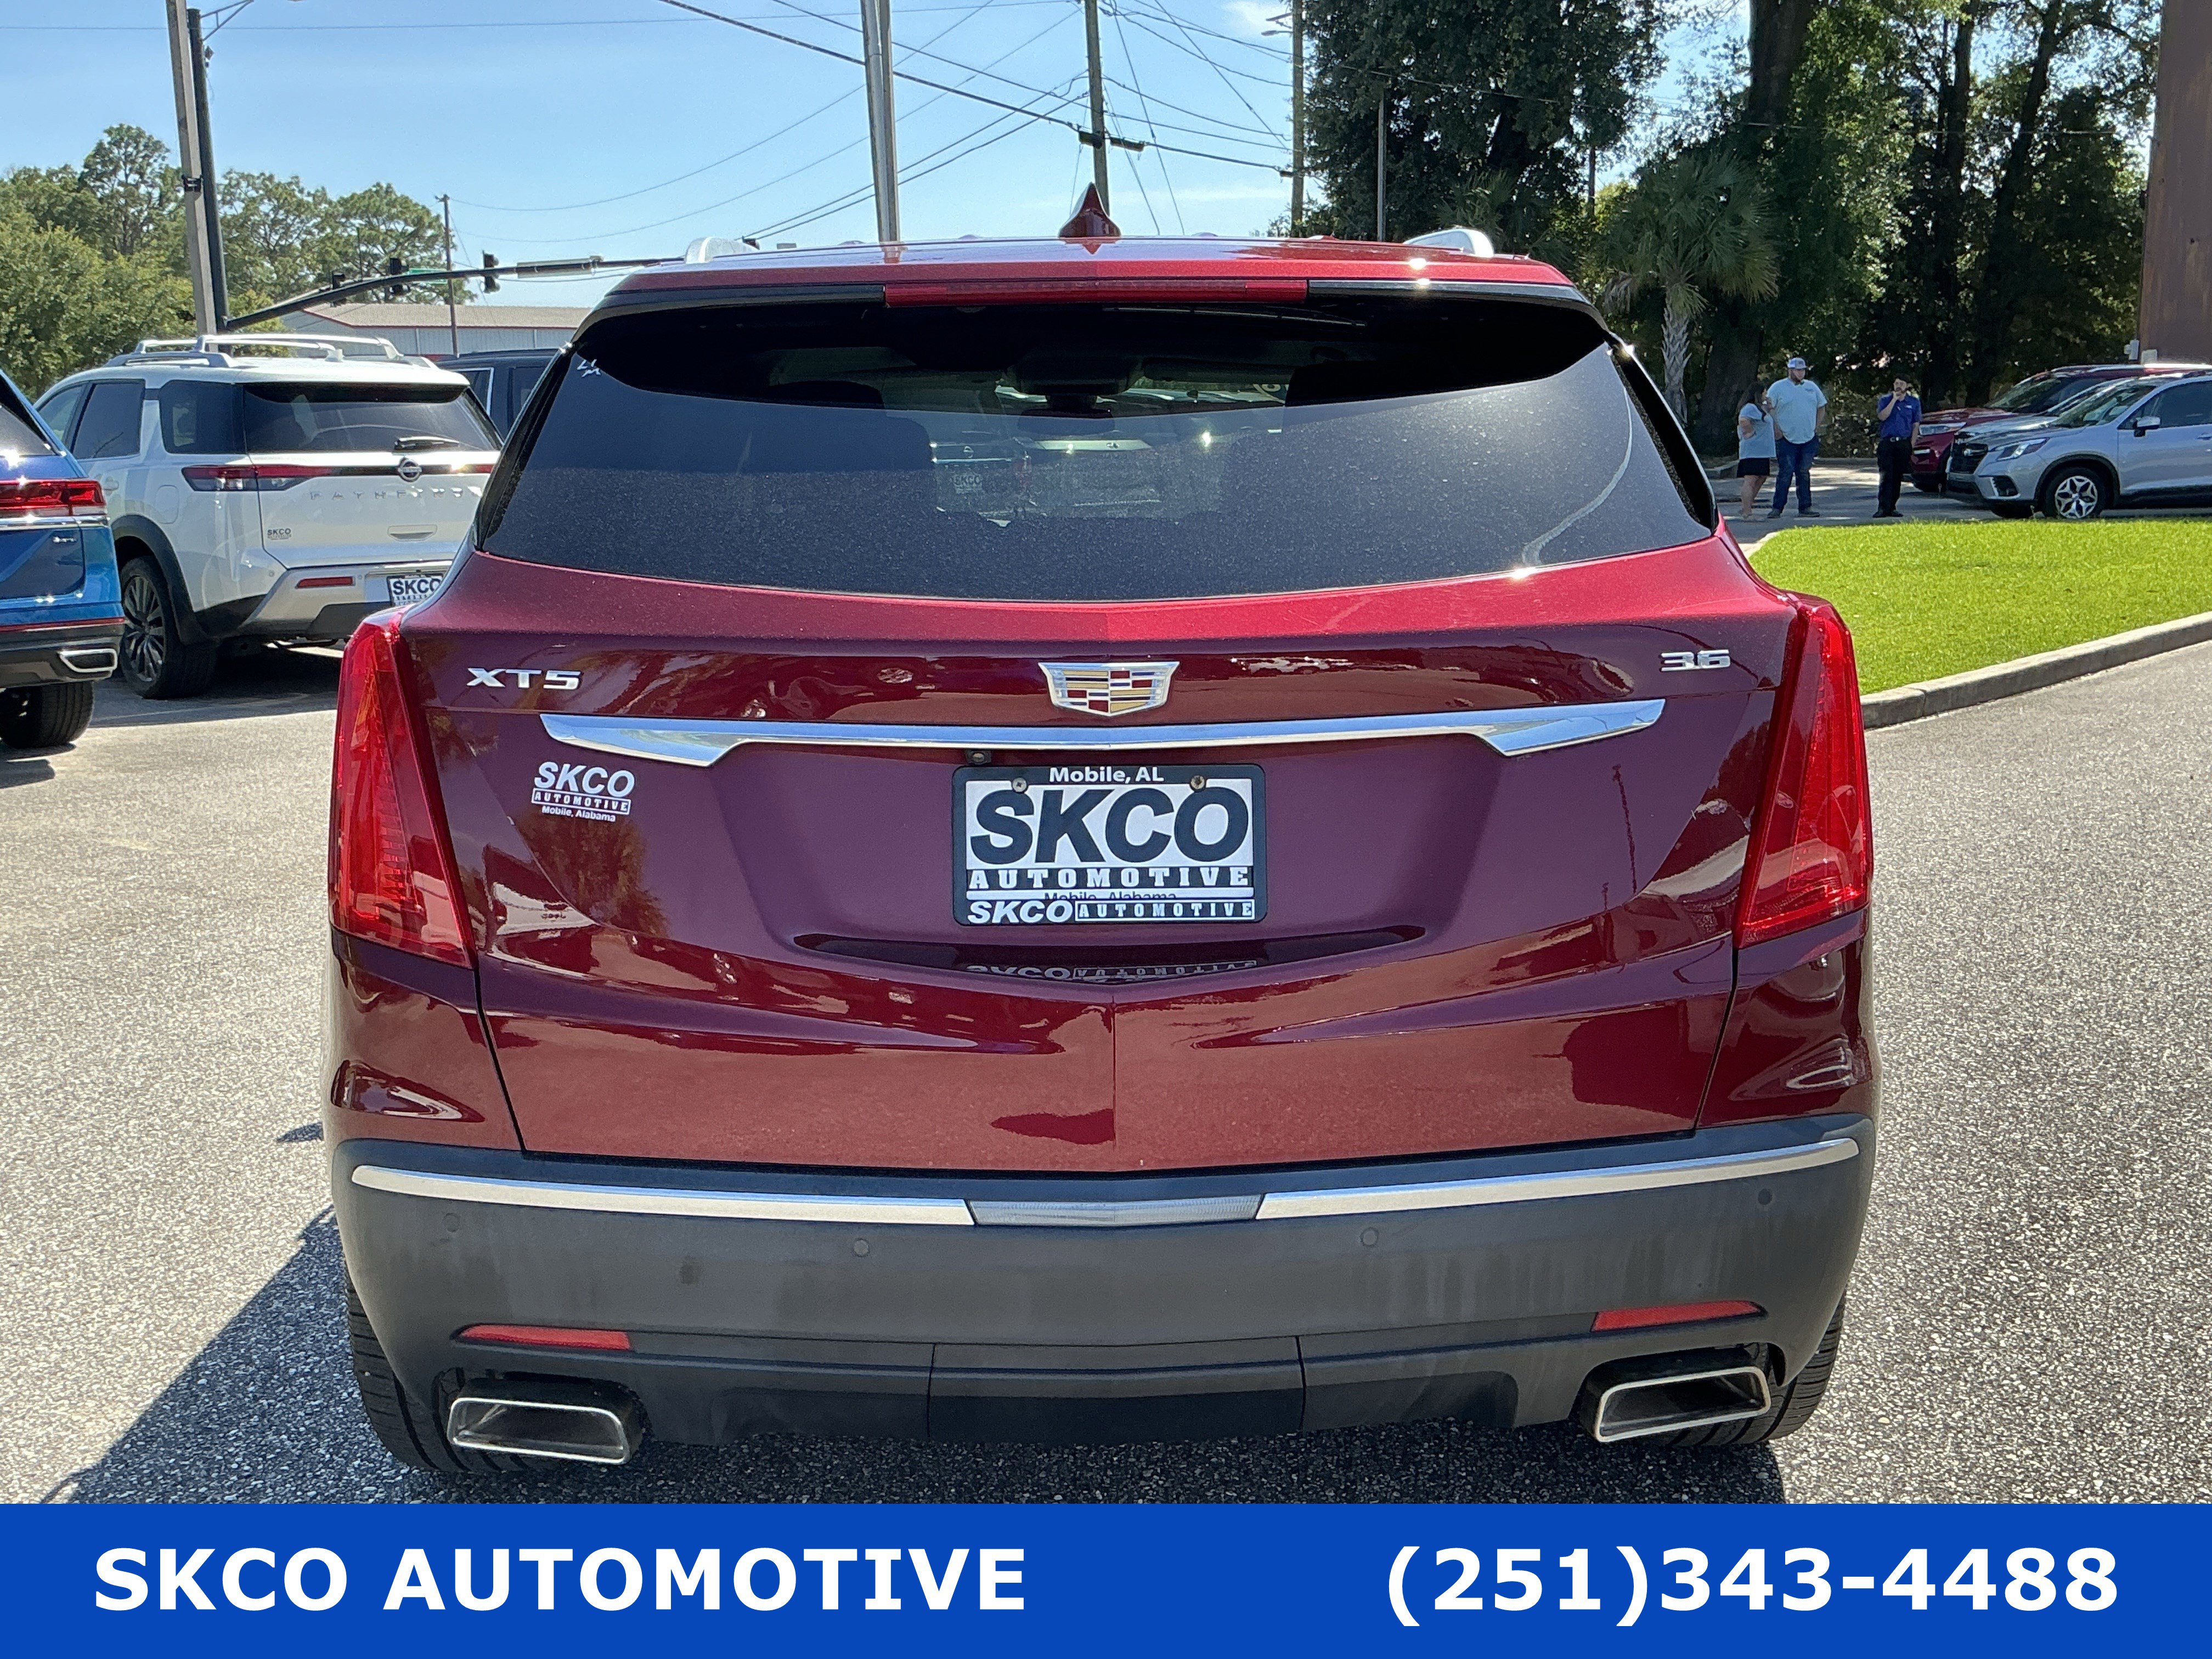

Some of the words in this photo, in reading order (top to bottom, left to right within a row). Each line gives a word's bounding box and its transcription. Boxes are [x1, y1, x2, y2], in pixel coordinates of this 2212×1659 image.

[393, 578, 442, 595] SKCO
[466, 667, 582, 690] XT5
[534, 761, 635, 797] SKCO
[1049, 766, 1131, 784] Mobile,
[1135, 766, 1165, 782] AL
[534, 791, 628, 811] AUTOMOTIVE
[541, 805, 574, 817] Mobile,
[575, 809, 616, 822] Alabama
[970, 786, 1249, 865] SKCO
[968, 866, 1249, 889] AUTOMOTIVE
[967, 900, 1073, 924] SKCO
[1079, 902, 1252, 918] AUTOMOTIVE
